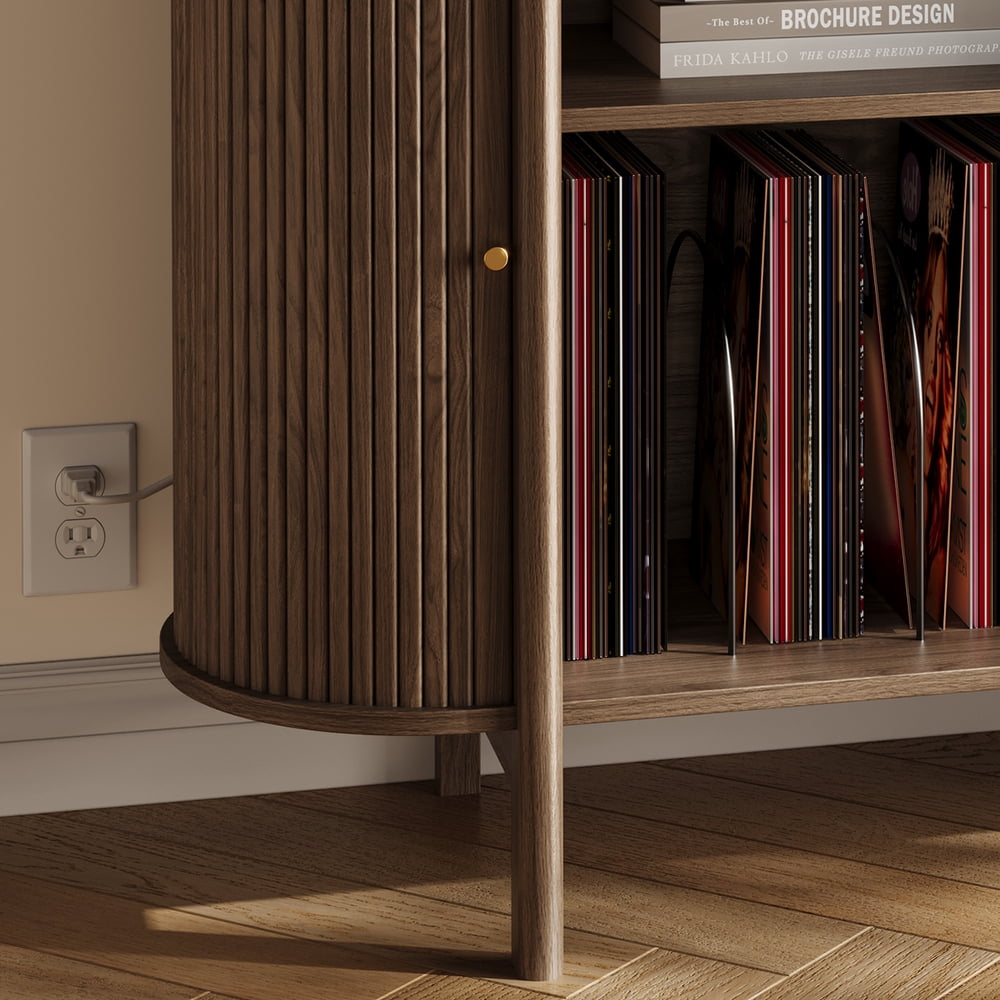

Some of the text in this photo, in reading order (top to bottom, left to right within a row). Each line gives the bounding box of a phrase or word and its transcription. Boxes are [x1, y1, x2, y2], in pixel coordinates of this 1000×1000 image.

[733, 17, 754, 26] Best
[781, 6, 882, 30] BROCHURE
[888, 3, 955, 25] DESIGN
[673, 53, 723, 67] FRIDA
[730, 50, 789, 65] KAHLO
[799, 50, 824, 61] THE
[827, 48, 871, 60] GISELE
[875, 47, 924, 58] FREUND
